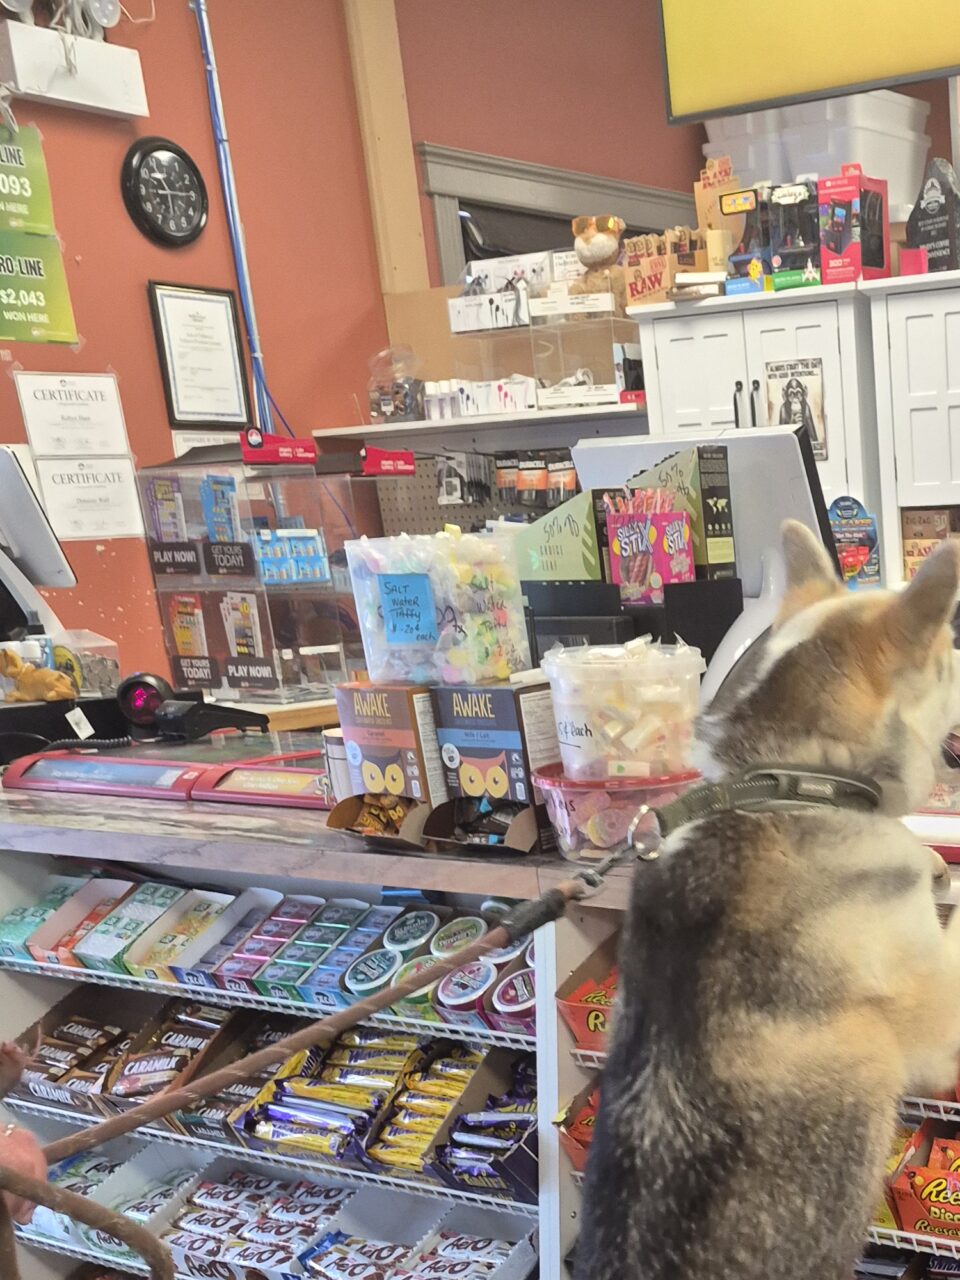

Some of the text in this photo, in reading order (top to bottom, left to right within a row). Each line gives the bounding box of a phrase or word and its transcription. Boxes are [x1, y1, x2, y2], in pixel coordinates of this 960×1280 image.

[18, 259, 44, 277] LINE
[629, 272, 664, 300] RAW
[3, 311, 49, 323] WON HERE
[33, 390, 106, 401] CERTIFICATE
[52, 473, 124, 484] CERTIFICATE
[154, 551, 196, 563] PLAY NOW!
[213, 555, 244, 567] TODAY!
[183, 667, 212, 680] TODAY!
[228, 665, 272, 678] PLAY NOW!
[353, 692, 391, 717] AWAKE
[453, 692, 495, 718] AWAKE
[124, 1056, 179, 1076] CARAMILK
[28, 1083, 72, 1104] CARAMILK
